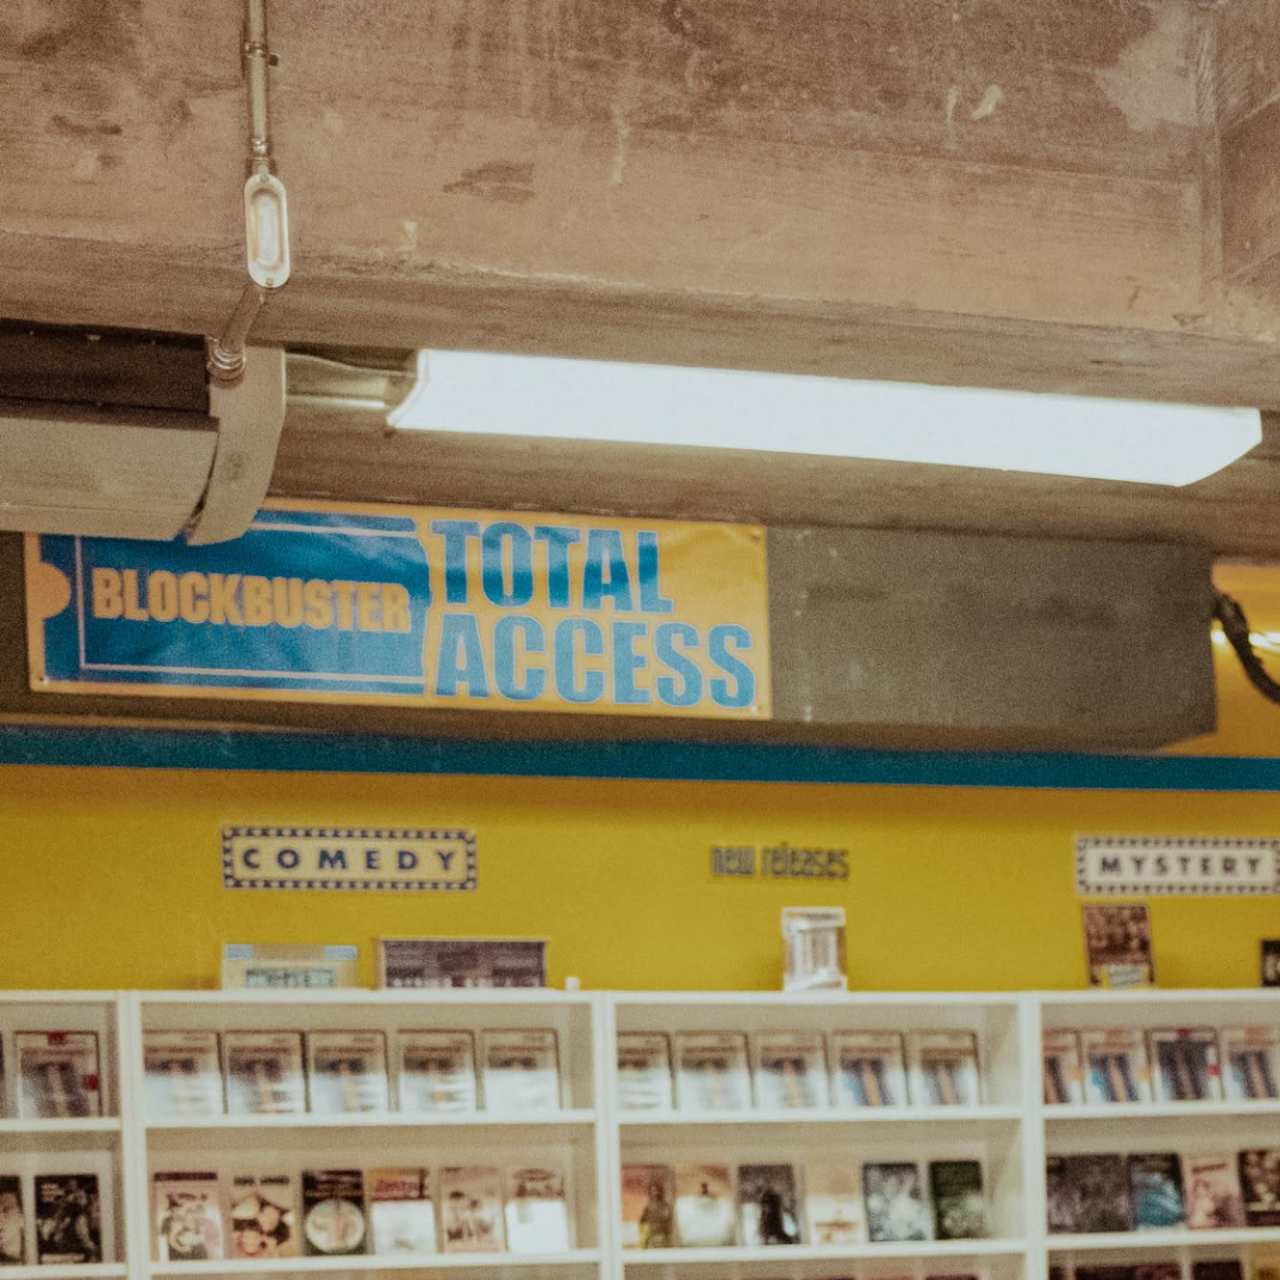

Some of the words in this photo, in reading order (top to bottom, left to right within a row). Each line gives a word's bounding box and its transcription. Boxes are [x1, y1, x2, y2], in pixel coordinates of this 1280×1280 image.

[92, 567, 412, 633] BLOCKBUSTER
[432, 520, 674, 614] TOTAL
[435, 613, 757, 709] ACCESS
[241, 846, 459, 873] COMEDY
[1099, 855, 1263, 876] MYSTERY
